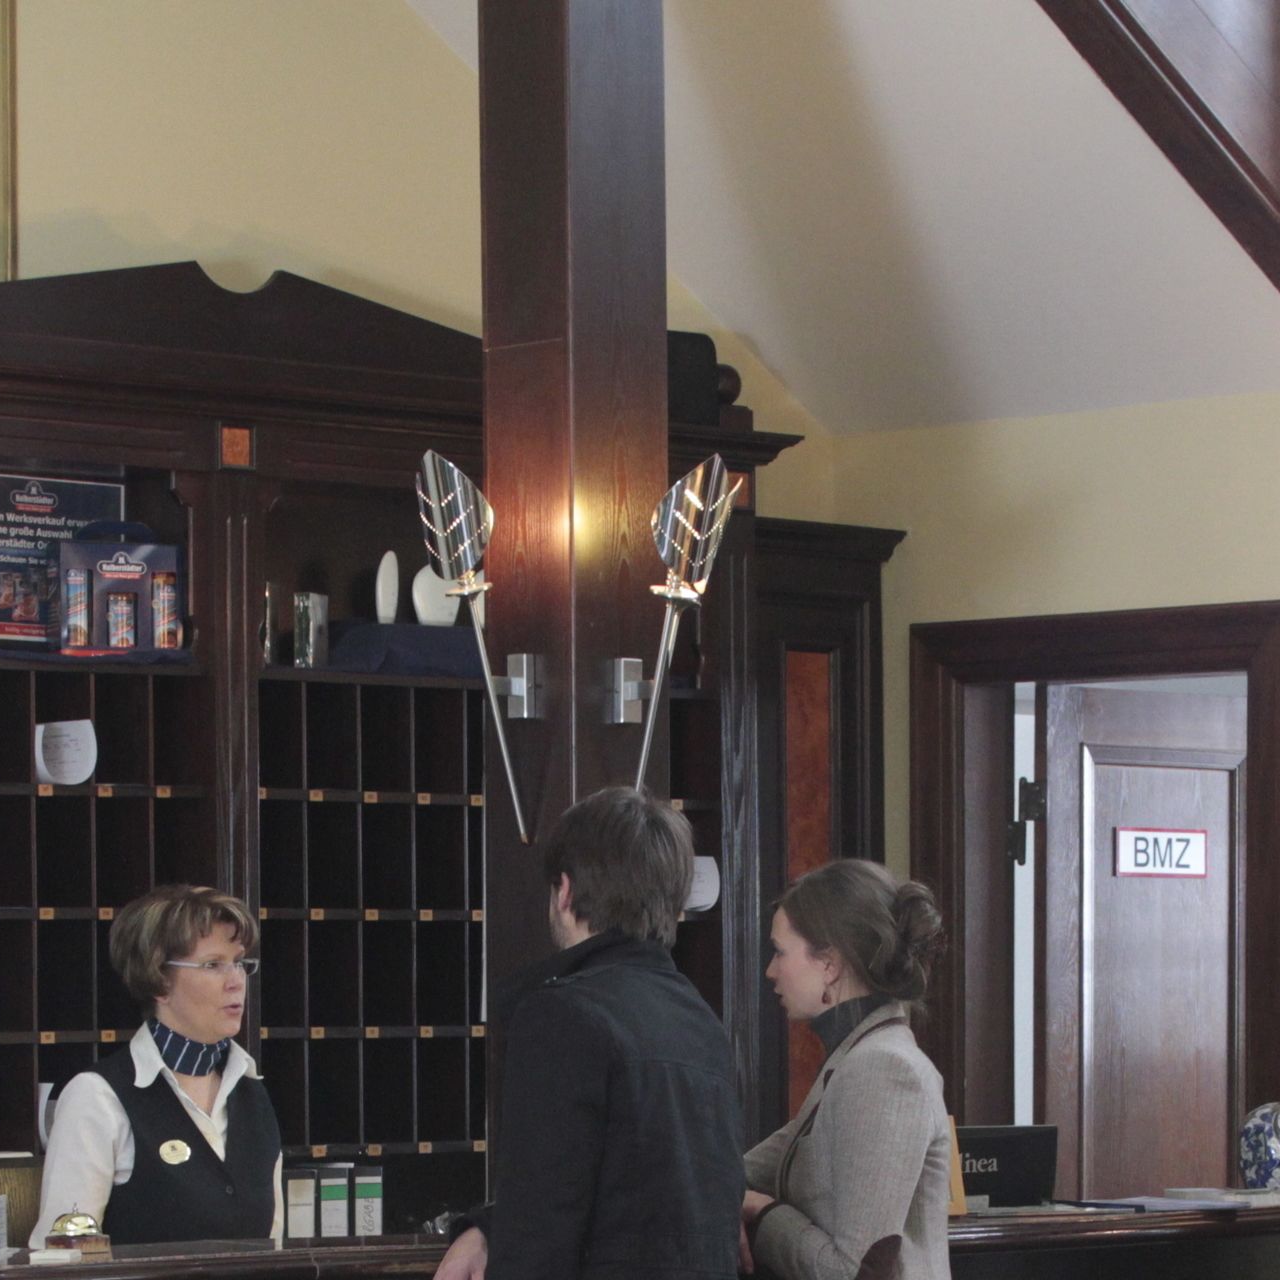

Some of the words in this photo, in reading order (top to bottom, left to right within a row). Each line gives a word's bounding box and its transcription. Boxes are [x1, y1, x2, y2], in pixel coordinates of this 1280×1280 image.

[6, 512, 65, 526] Werksverkauf
[9, 526, 34, 538] große
[36, 528, 72, 539] Auswahl
[1134, 836, 1191, 869] BMZ
